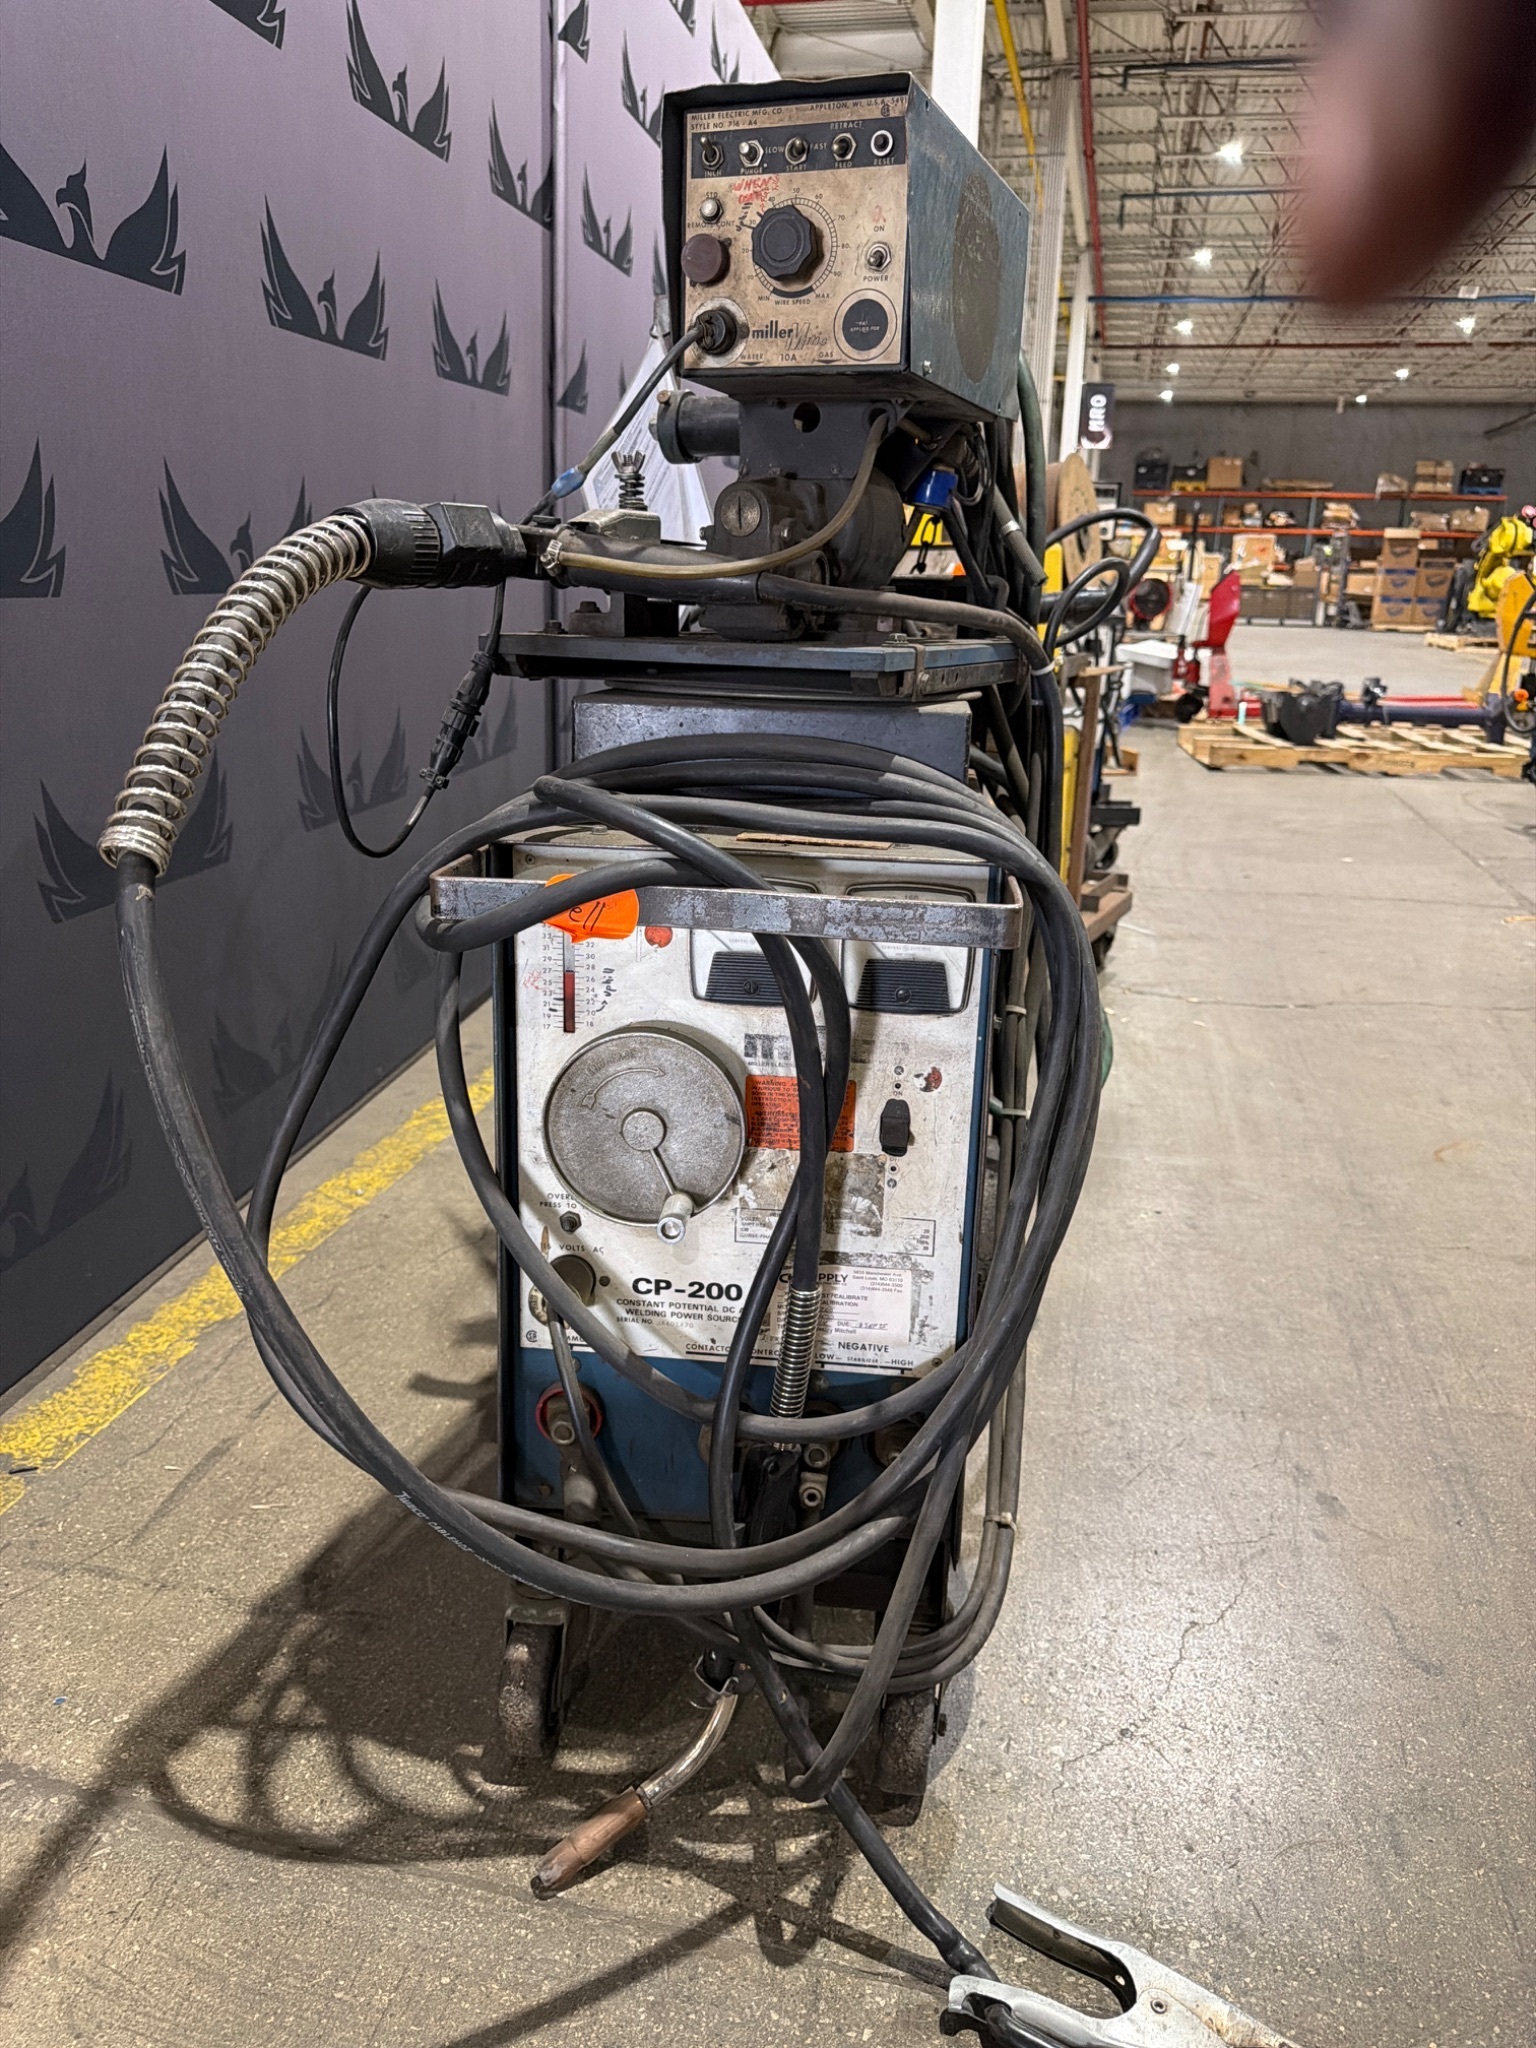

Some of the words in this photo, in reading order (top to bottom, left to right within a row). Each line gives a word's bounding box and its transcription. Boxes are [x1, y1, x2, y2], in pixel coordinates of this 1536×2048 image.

[691, 113, 715, 121] MILLER
[718, 110, 750, 119] ELECTRIC
[691, 122, 710, 131] STYLE
[829, 121, 863, 130] RETRACT
[765, 146, 784, 154] SLOW
[810, 142, 827, 151] FAST
[873, 157, 895, 166] RESET
[786, 164, 807, 172] START
[704, 170, 722, 178] INCH
[752, 320, 793, 339] miller
[780, 354, 797, 362] 10A
[818, 350, 834, 358] GAS
[559, 1243, 585, 1252] VOLTS
[593, 1246, 605, 1254] AC
[818, 1273, 849, 1283] PPLY
[632, 1277, 743, 1301] CP-200
[616, 1298, 665, 1308] CONSTANT
[669, 1302, 718, 1312] POTENTIAL
[722, 1306, 736, 1314] DC
[616, 1316, 640, 1324] SERIAL
[625, 1308, 667, 1318] WELDING
[670, 1311, 704, 1320] POWER
[707, 1313, 742, 1323] SOURC
[686, 1343, 731, 1353] CONTACTO
[837, 1341, 890, 1353] NEGATIVE
[891, 1358, 914, 1366] HIGH
